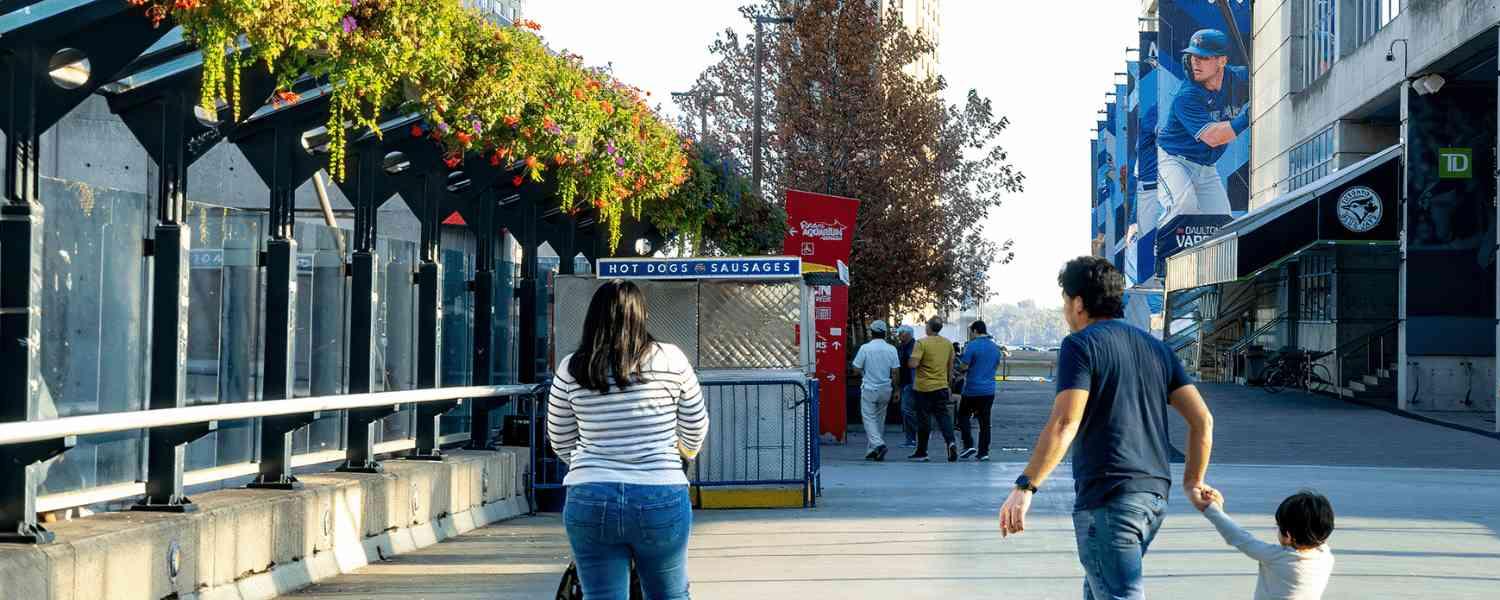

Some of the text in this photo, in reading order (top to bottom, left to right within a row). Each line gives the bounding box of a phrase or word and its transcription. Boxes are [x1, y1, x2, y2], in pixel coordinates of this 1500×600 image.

[1440, 153, 1468, 172] TD
[609, 262, 791, 273] HOT DOGS SAUSAGES
